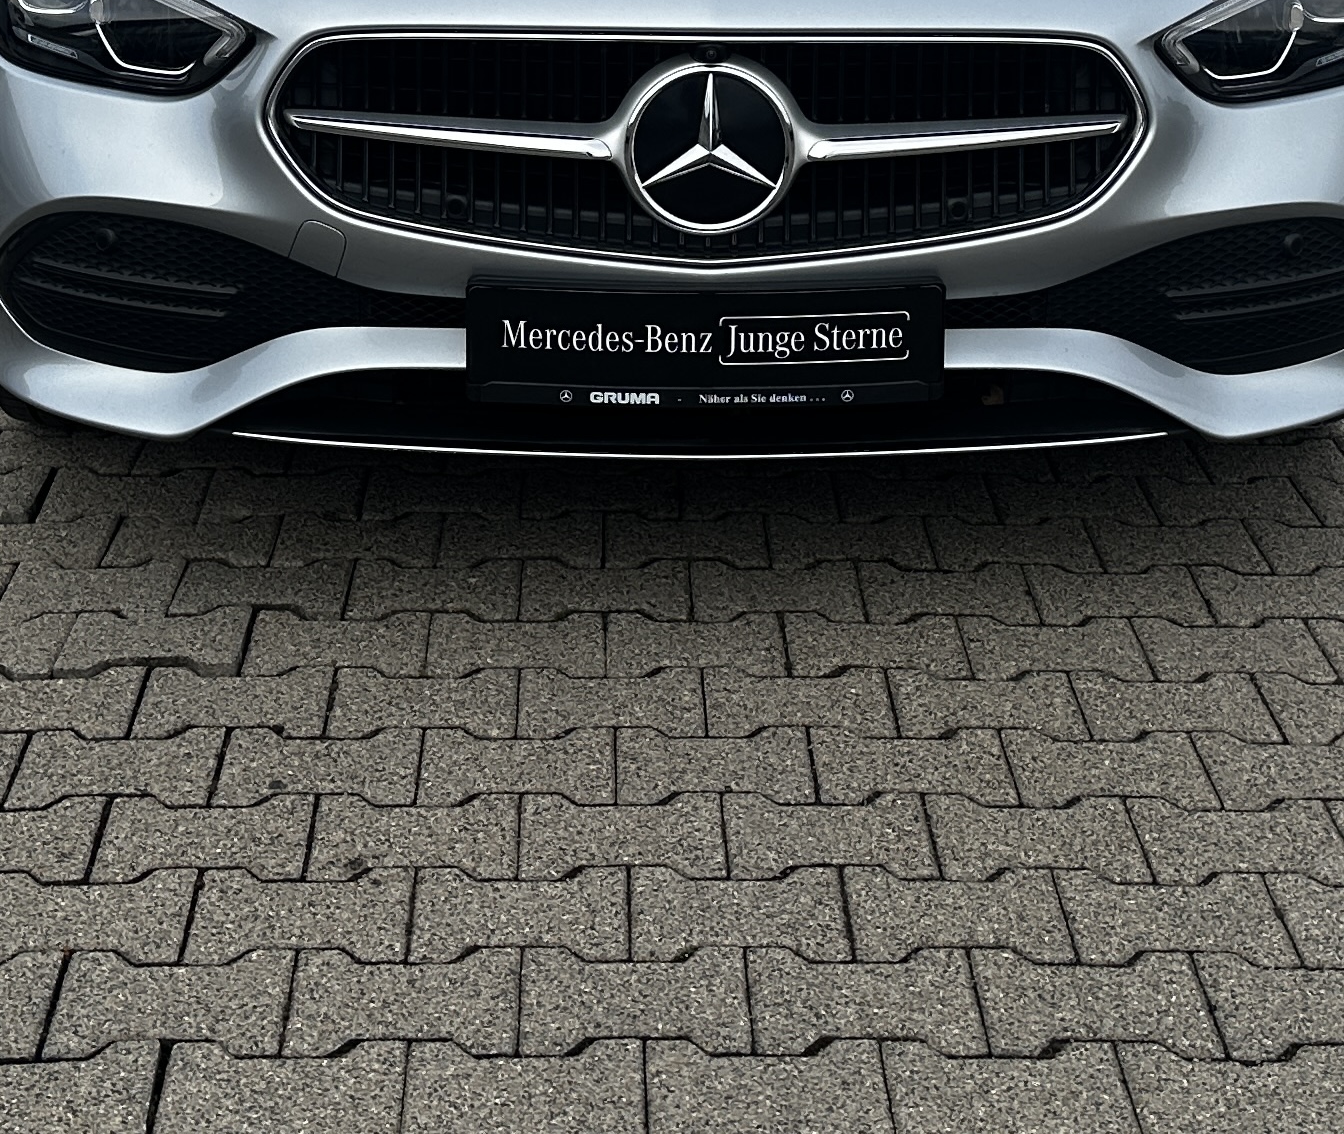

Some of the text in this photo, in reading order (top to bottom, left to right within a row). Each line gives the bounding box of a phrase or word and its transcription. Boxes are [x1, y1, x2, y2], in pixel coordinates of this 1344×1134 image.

[501, 319, 903, 359] Mercedes-Benz Junge Sterne
[589, 391, 660, 405] GRUMA
[698, 393, 731, 404] Näher
[733, 393, 749, 403] als
[750, 393, 767, 403] Sie
[769, 392, 807, 403] denken
